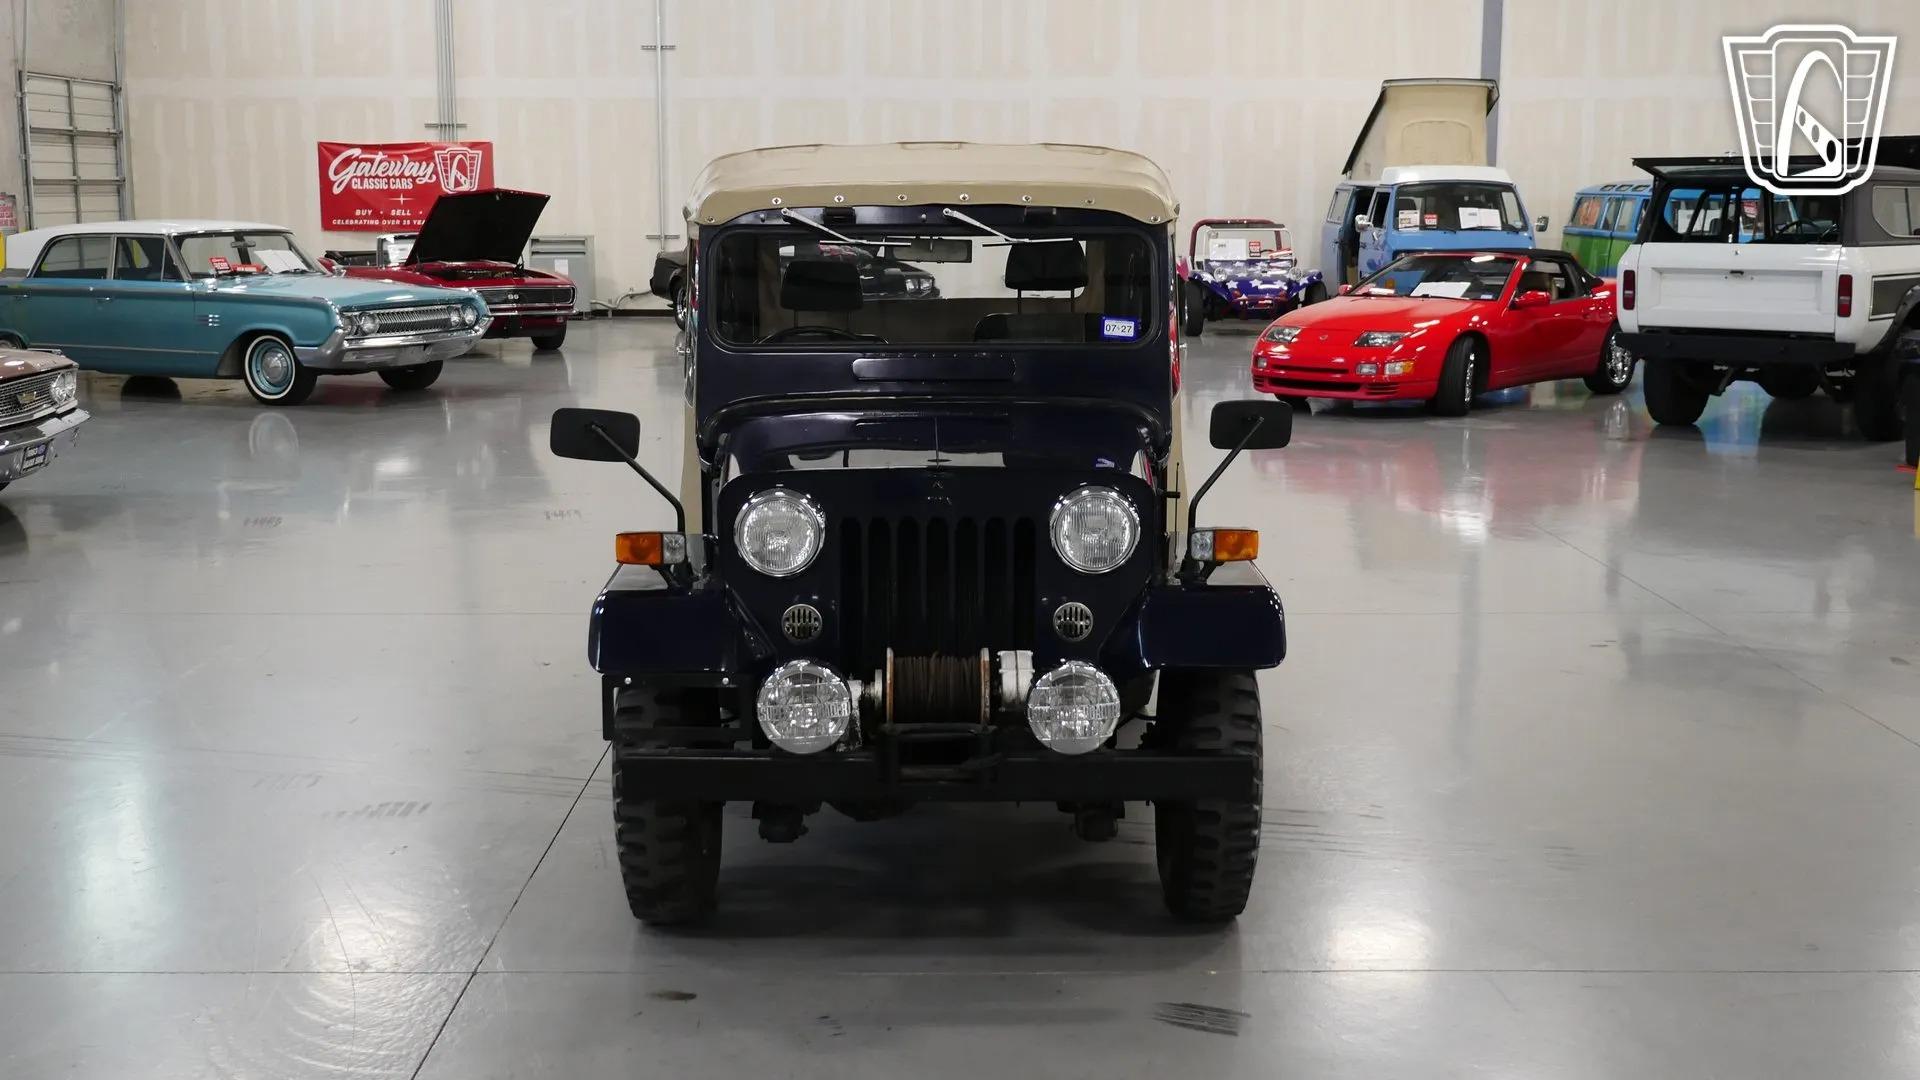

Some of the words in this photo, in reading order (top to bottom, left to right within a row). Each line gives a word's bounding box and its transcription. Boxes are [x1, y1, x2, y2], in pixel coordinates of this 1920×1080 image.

[328, 147, 437, 195] Gateway
[351, 177, 388, 190] CLASSIC
[389, 177, 413, 190] CARS
